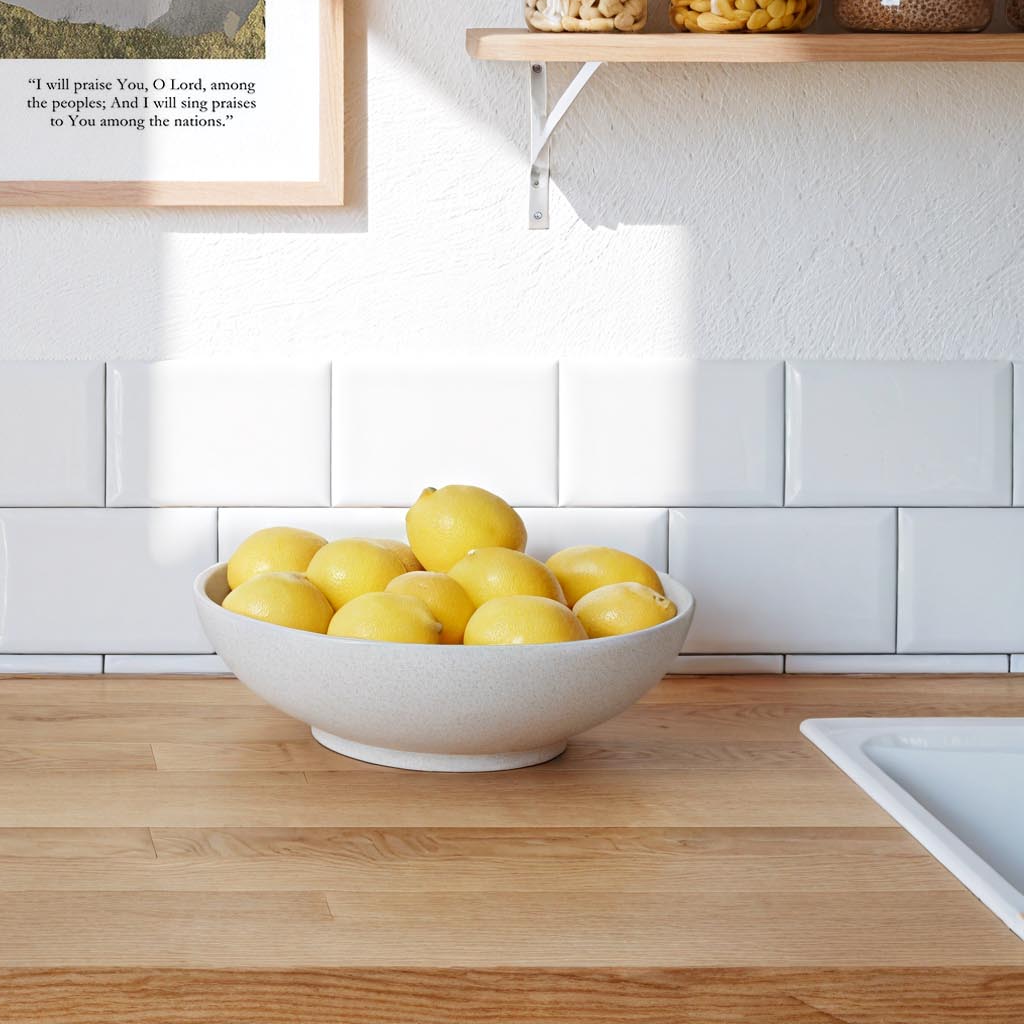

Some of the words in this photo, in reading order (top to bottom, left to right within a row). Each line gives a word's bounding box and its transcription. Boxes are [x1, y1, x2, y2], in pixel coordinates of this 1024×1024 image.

[28, 78, 42, 91] “I
[46, 78, 70, 91] will
[73, 78, 113, 95] praise
[116, 78, 149, 93] You,
[152, 78, 166, 91] O
[170, 77, 207, 93] Lord,
[210, 81, 256, 95] among
[27, 96, 48, 109] the
[51, 96, 107, 113] peoples;
[110, 96, 139, 109] And
[142, 96, 149, 109] I
[152, 96, 177, 109] will
[180, 96, 209, 113] sing
[211, 96, 257, 113] praises
[50, 116, 64, 127] to
[68, 115, 96, 127] You
[99, 118, 146, 131] among
[149, 114, 170, 127] the
[174, 114, 234, 127] nations.”
